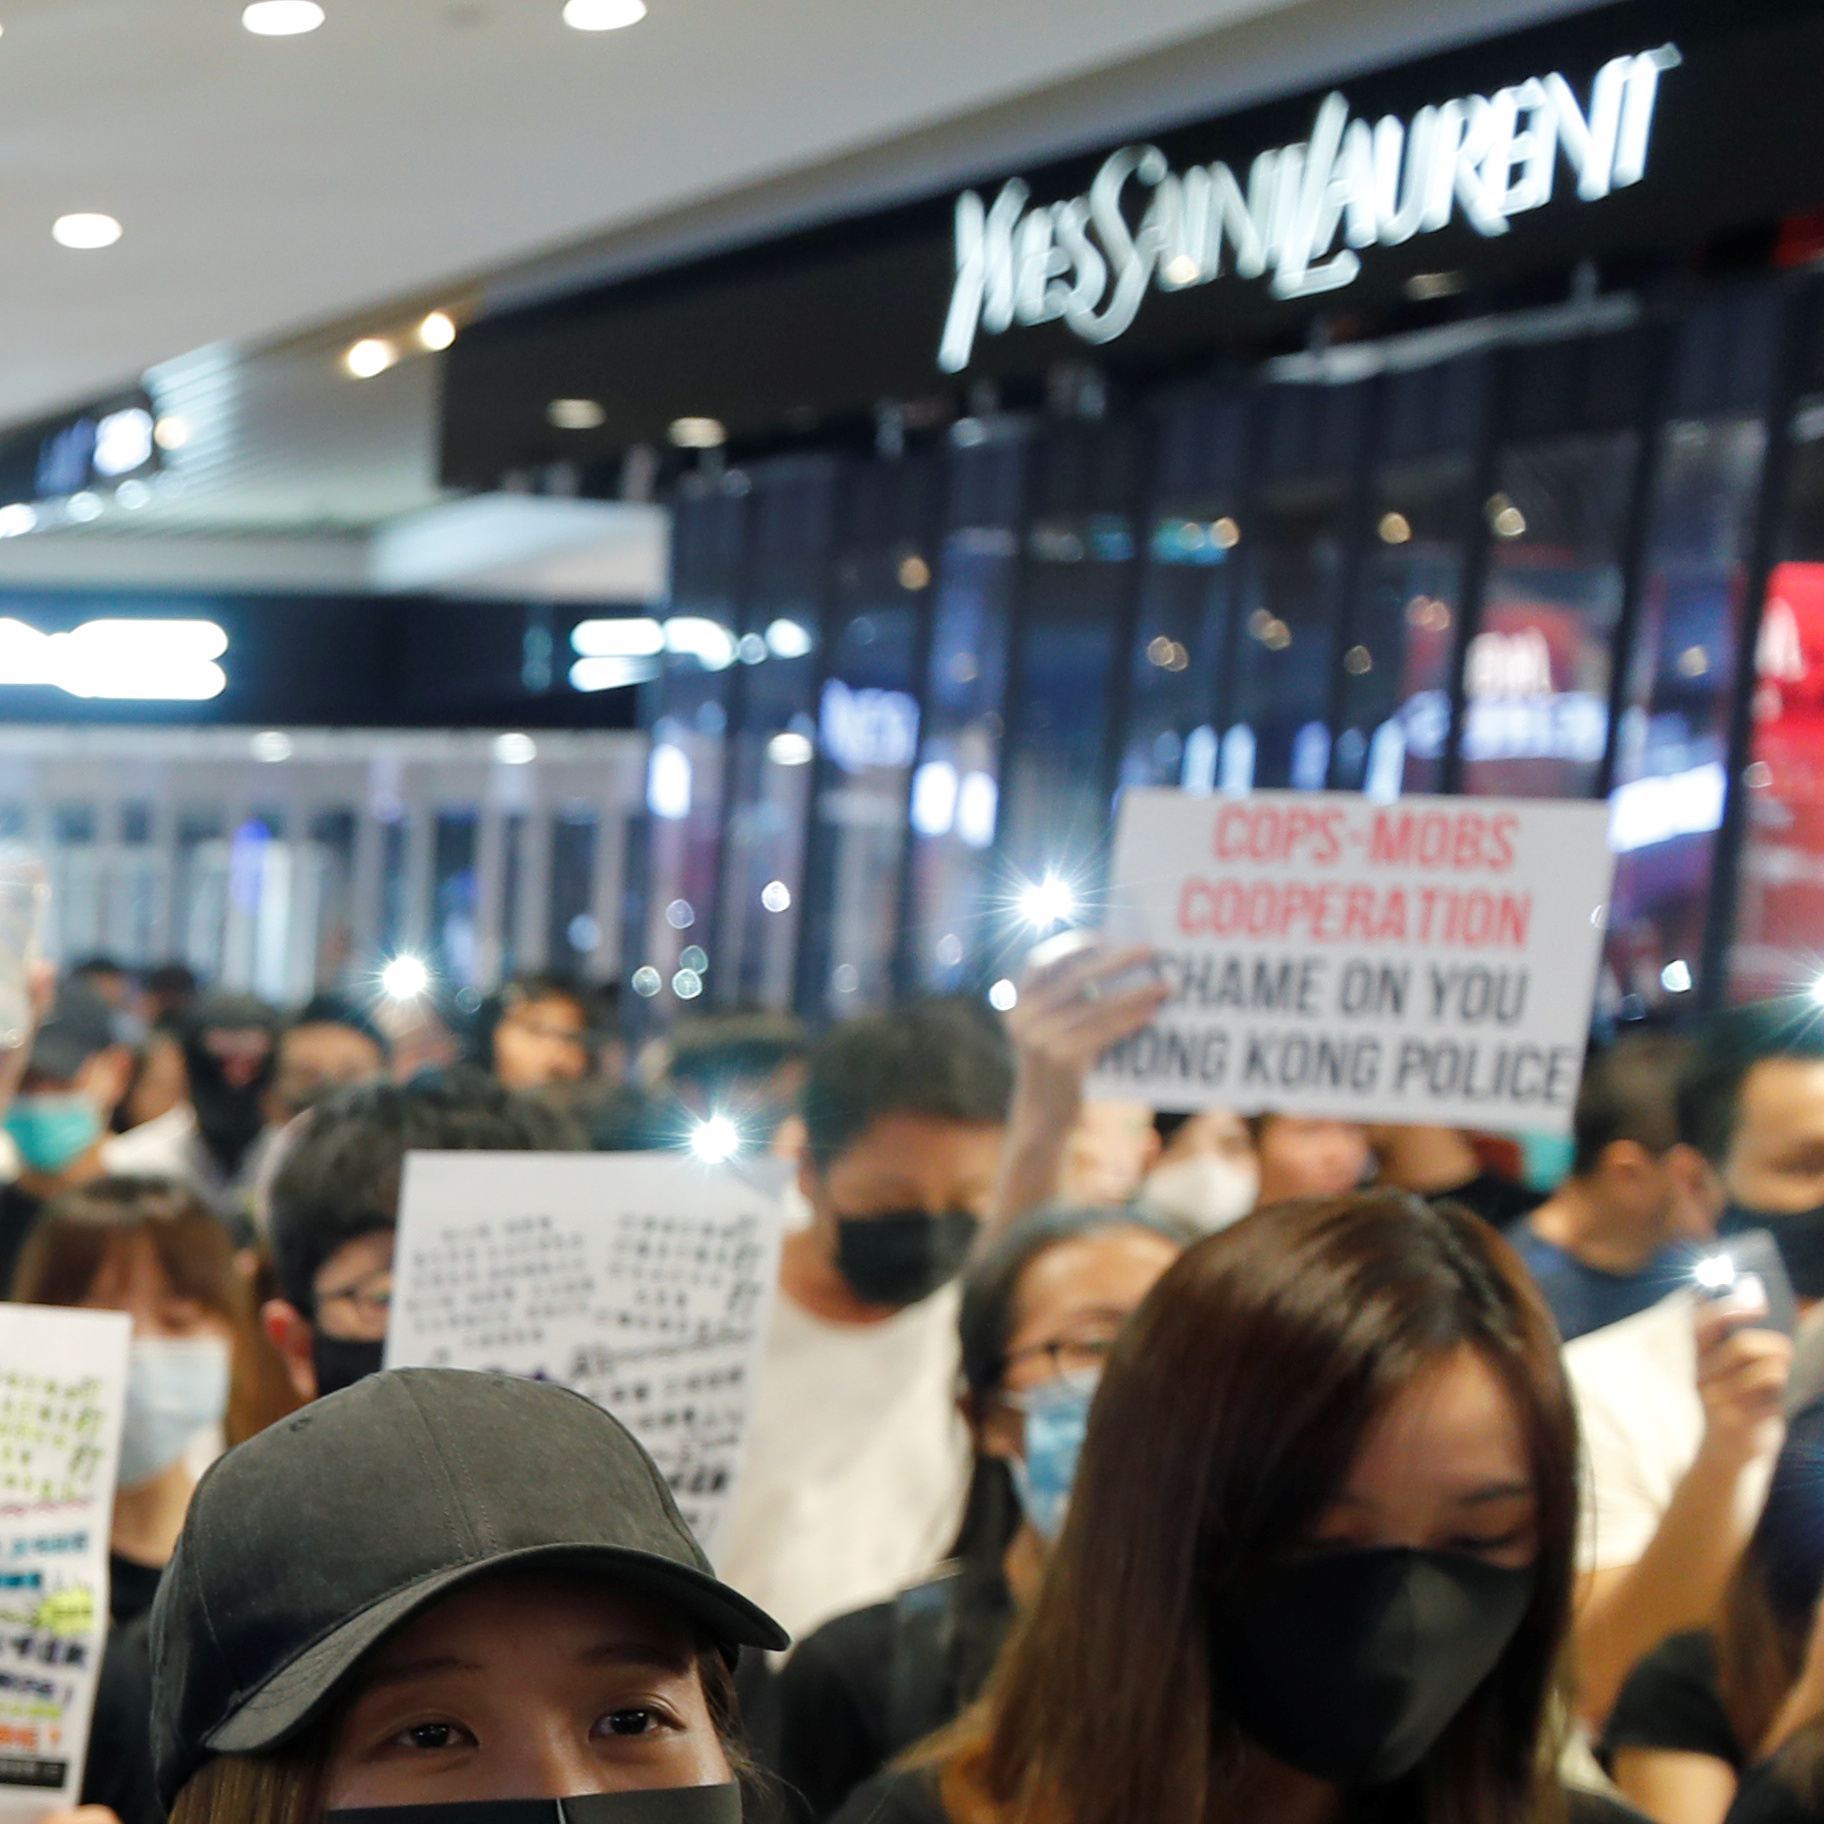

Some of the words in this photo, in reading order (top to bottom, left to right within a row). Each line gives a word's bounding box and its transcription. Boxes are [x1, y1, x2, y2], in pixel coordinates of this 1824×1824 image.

[1214, 804, 1518, 871] COPS-MOBS
[1178, 877, 1532, 949] COOPERATION
[1338, 959, 1411, 1019] ON
[1429, 965, 1529, 1027] YOU
[1243, 1034, 1384, 1100] KONG
[1391, 1042, 1577, 1106] POLICE
